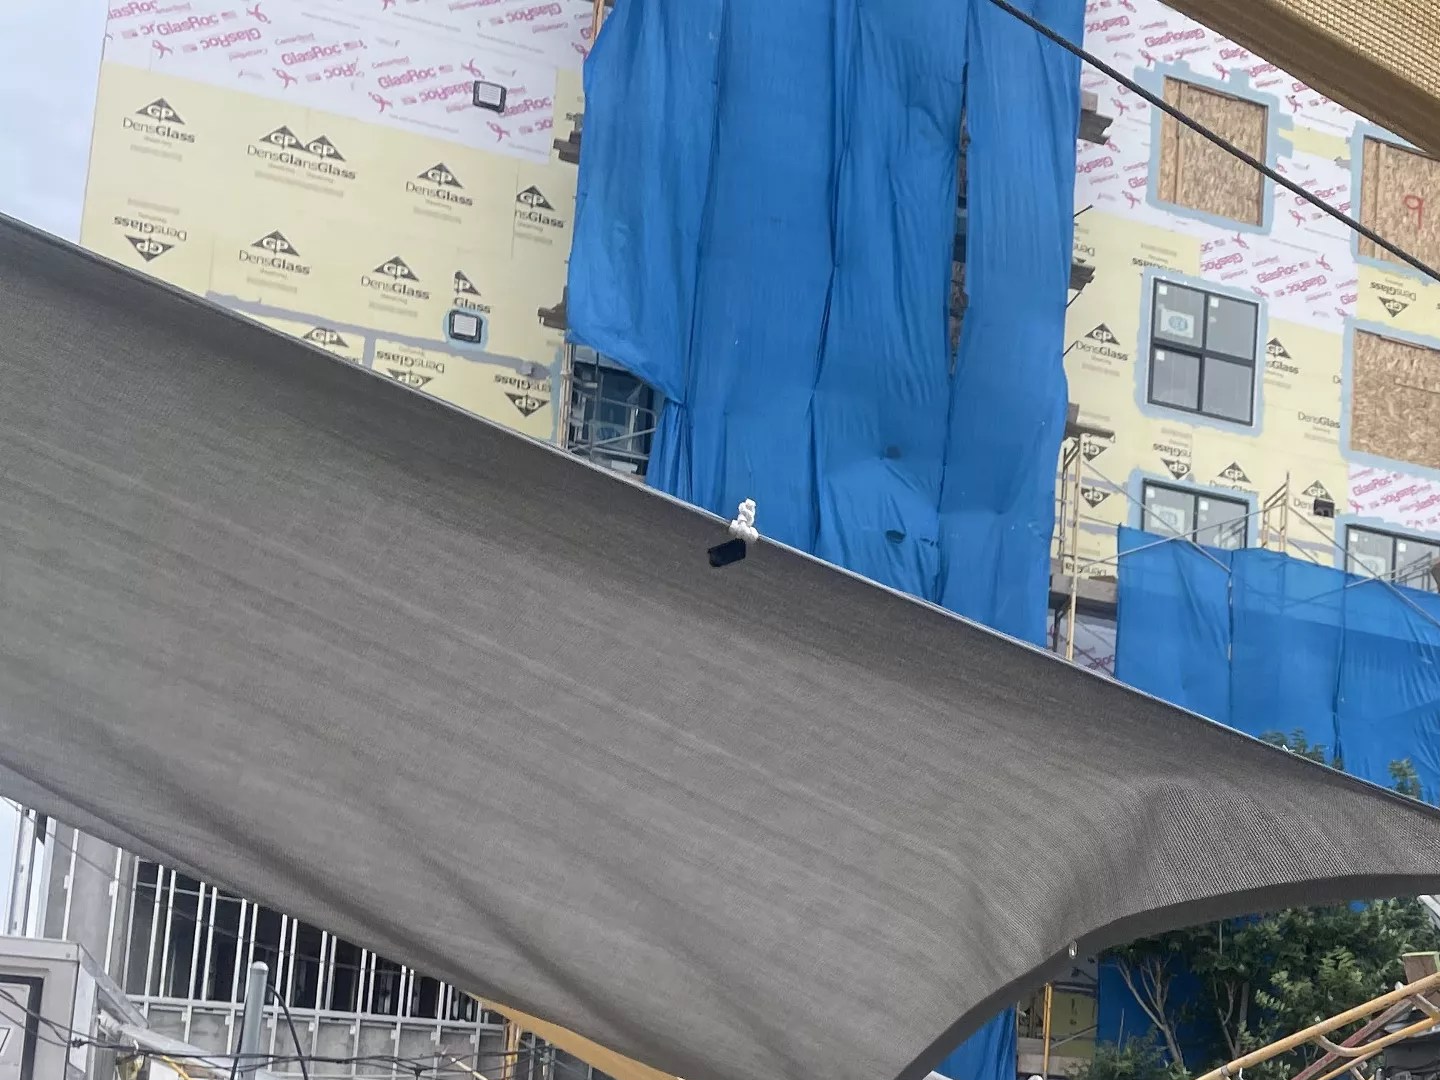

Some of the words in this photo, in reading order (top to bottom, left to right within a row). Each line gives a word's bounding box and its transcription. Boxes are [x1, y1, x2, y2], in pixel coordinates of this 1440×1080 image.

[156, 15, 219, 36] GlasRoc
[200, 28, 261, 49] GlasRoc
[281, 42, 342, 66] GlasRoc
[378, 67, 437, 90] GlasRoc
[503, 97, 552, 117] lasRoc
[123, 117, 195, 143] DensGlass
[405, 181, 473, 206] DensGlass
[1404, 194, 1423, 230] 9
[114, 215, 187, 241] DensGlass
[239, 250, 311, 275] DensGlass
[361, 276, 430, 300] DensGlass
[1370, 281, 1416, 302] DensGlass
[453, 297, 491, 314] Glass
[377, 351, 445, 373] DensGlass
[1076, 341, 1128, 361] DensGlass
